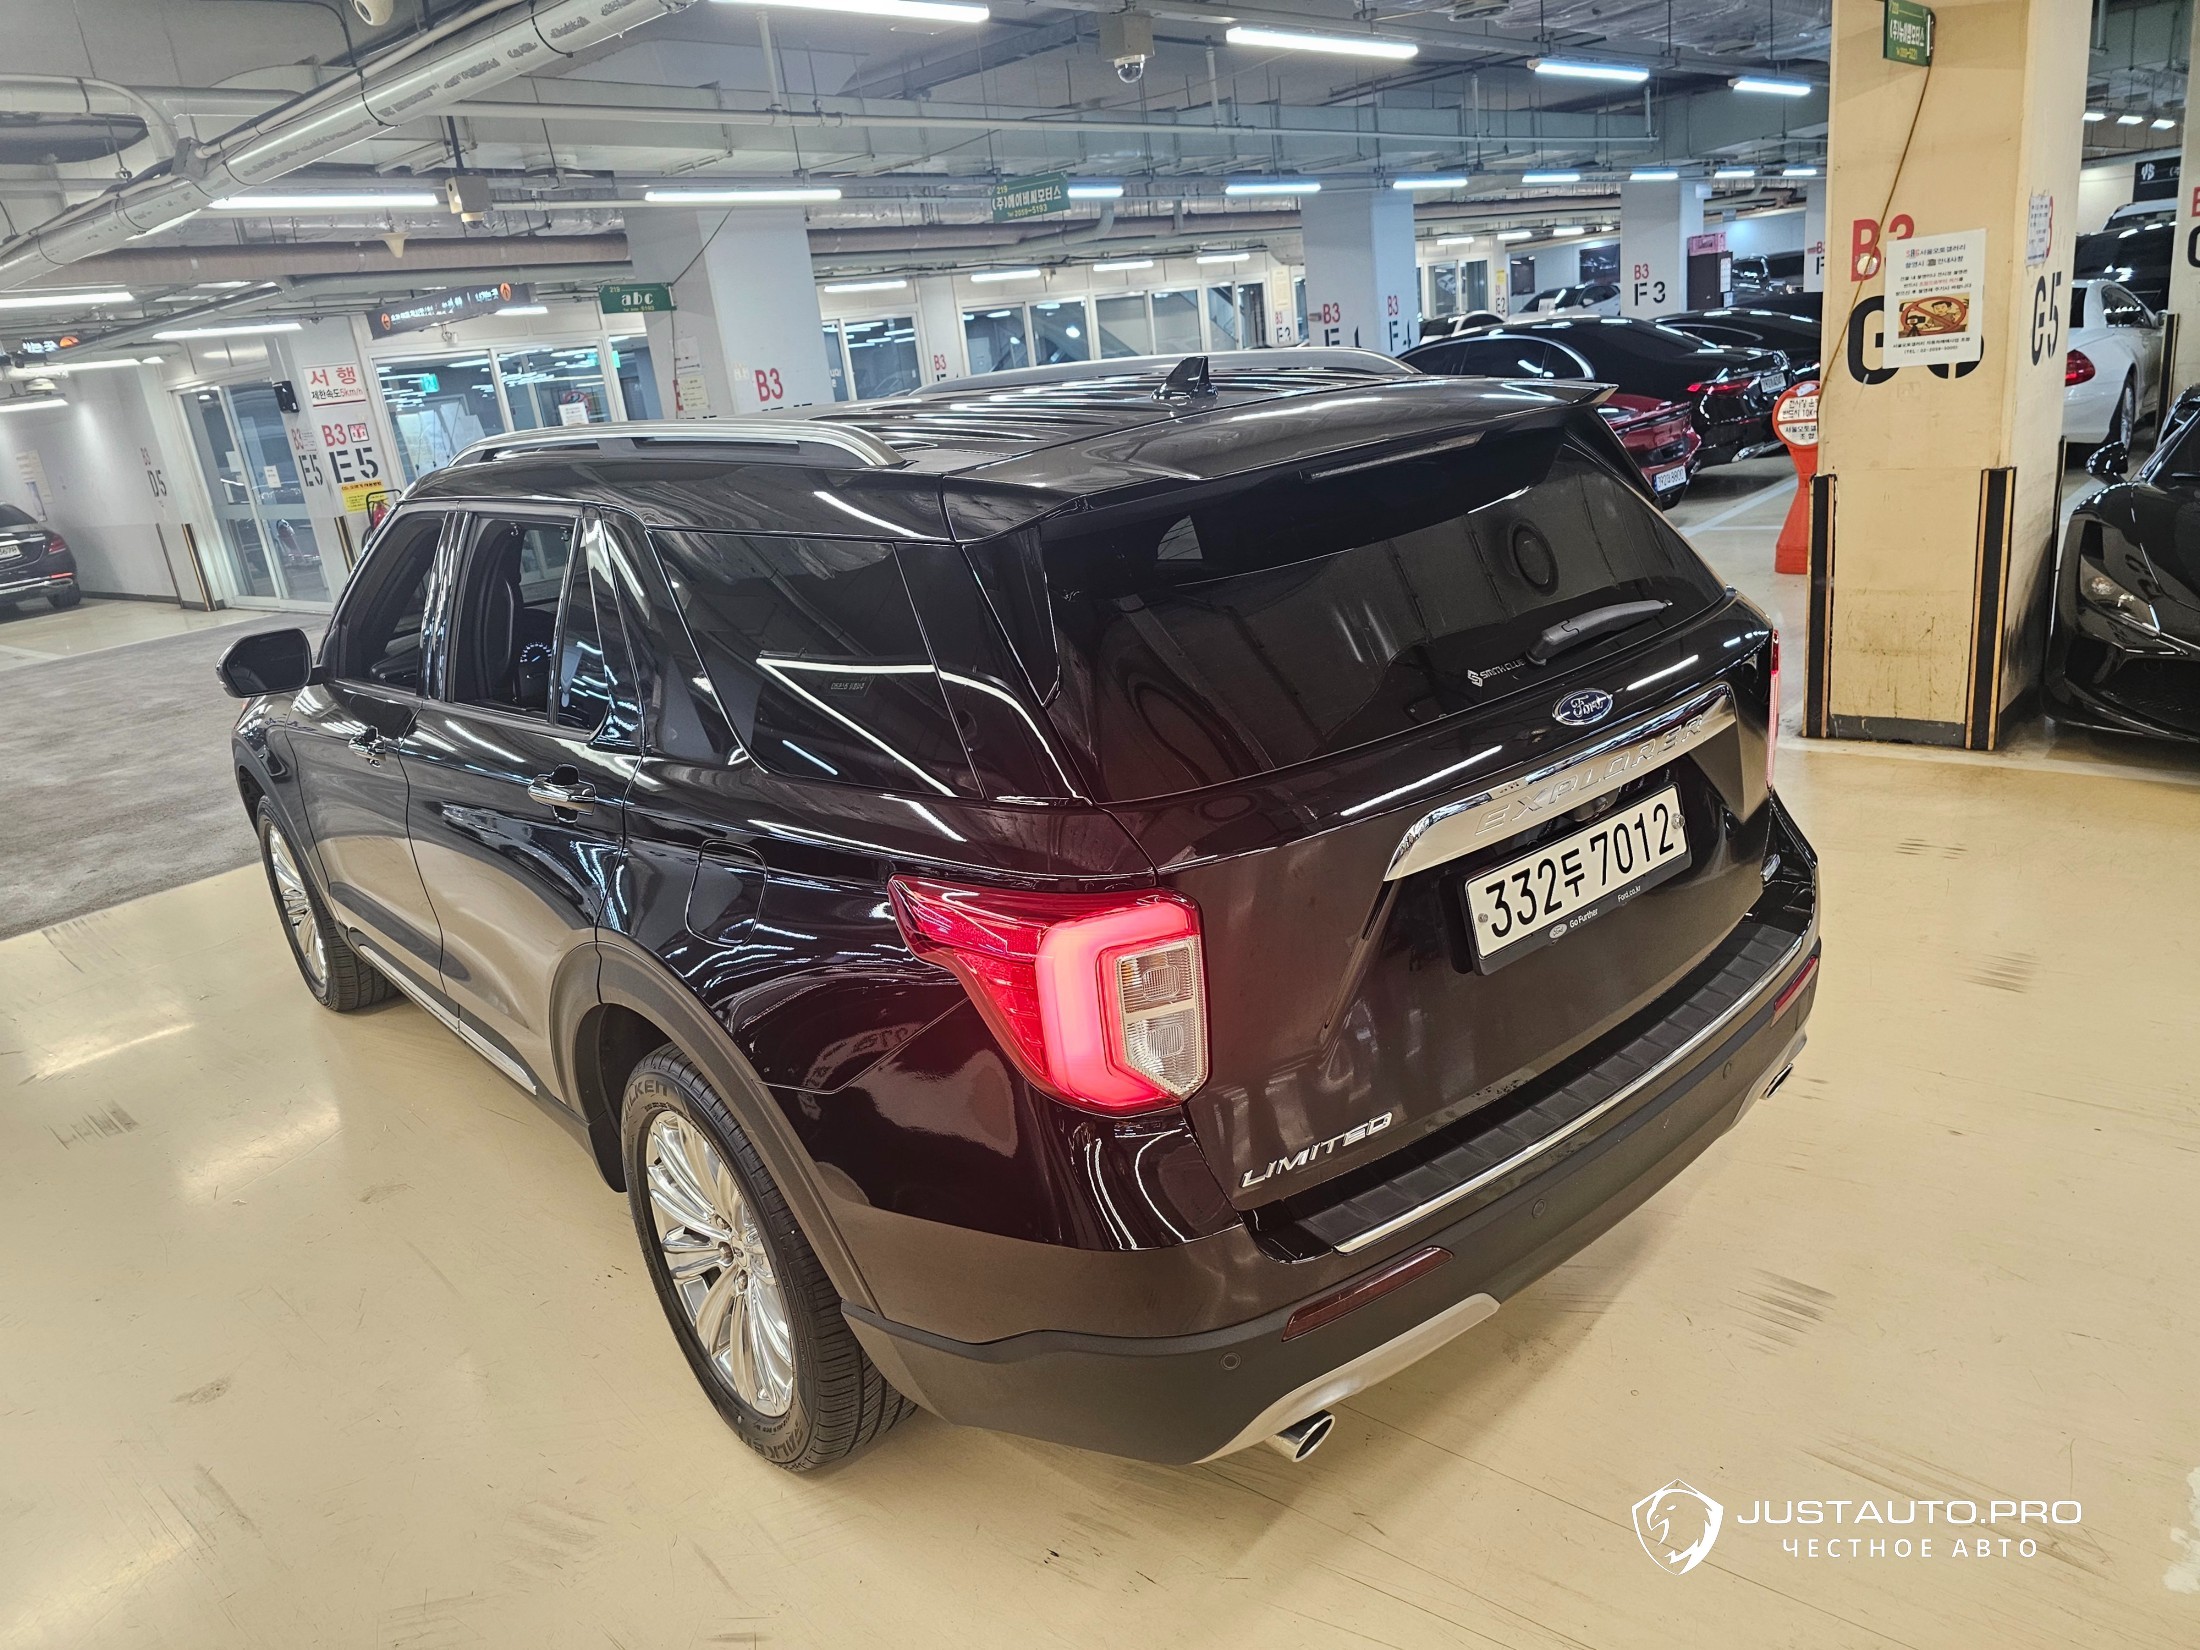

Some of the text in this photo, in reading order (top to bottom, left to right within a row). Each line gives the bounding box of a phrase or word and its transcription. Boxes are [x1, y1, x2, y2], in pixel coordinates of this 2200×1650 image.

[992, 185, 1062, 211] (주)에이비씨모터스
[996, 185, 1008, 194] 219
[1634, 263, 1650, 280] B3
[621, 291, 654, 306] abc
[1387, 294, 1399, 317] B3
[1634, 281, 1666, 307] F3
[1323, 302, 1341, 324] B3
[1848, 295, 1985, 385] G
[934, 354, 946, 371] B3
[310, 366, 357, 387] 서 행
[755, 367, 784, 402] B3
[321, 423, 347, 448] B3
[298, 454, 324, 487] E5
[329, 446, 379, 484] E5
[147, 469, 168, 497] D5
[1570, 694, 1605, 719] Ford
[1475, 714, 1704, 836] EXPLORER
[1485, 803, 1675, 938] 332두 7012
[1569, 918, 1579, 928] Go
[1578, 908, 1599, 924] Further
[1617, 885, 1641, 903] Ford.co.kr
[1240, 1111, 1393, 1188] LIMITED
